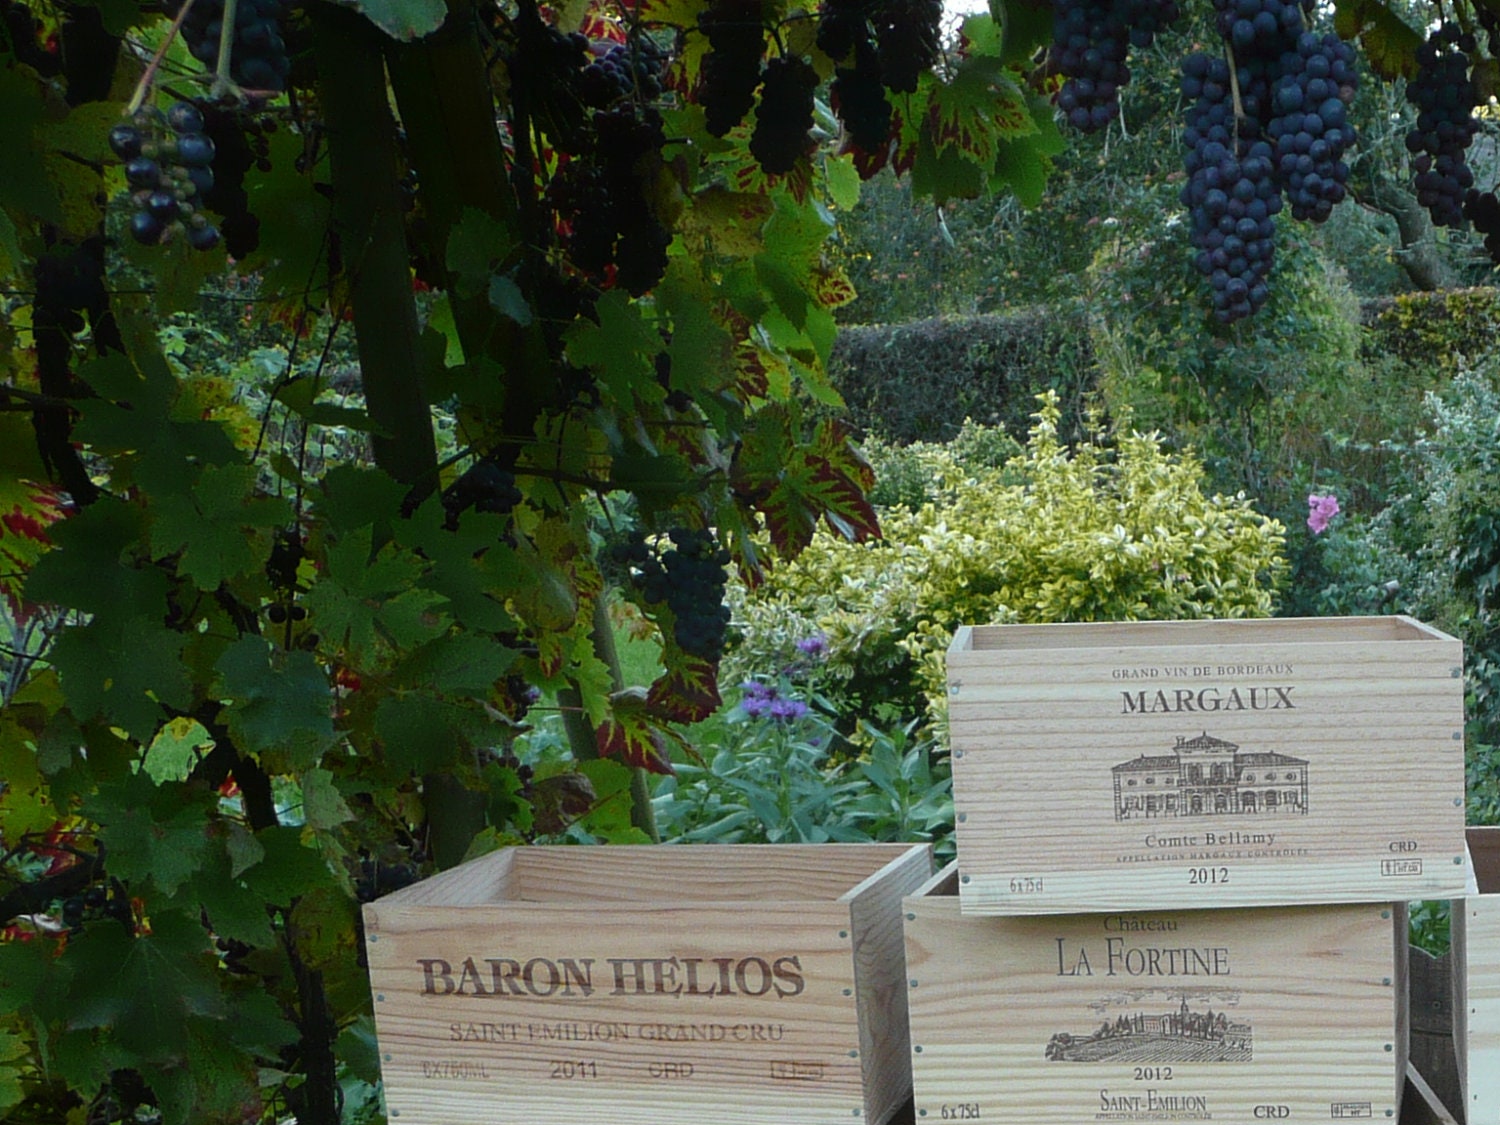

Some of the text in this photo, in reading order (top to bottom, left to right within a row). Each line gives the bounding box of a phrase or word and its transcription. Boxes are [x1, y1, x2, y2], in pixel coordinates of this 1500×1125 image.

[1112, 664, 1294, 679] GRAND VIN DE BORDEAUX
[1120, 686, 1296, 714] MARGAUX
[1145, 831, 1276, 848] Comte Bellamy
[1389, 841, 1418, 852] CRD
[1188, 867, 1229, 884] 2012
[1103, 916, 1178, 932] Château
[1056, 937, 1230, 976] LA FORTINE
[417, 955, 805, 998] BARON HELIOS
[449, 1022, 785, 1042] SAINT EMILION GRAND CRU
[550, 1060, 598, 1079] 2011
[648, 1062, 694, 1078] CRD
[1134, 1066, 1173, 1081] 2012
[941, 1103, 950, 1120] 6
[1253, 1105, 1290, 1119] CRD
